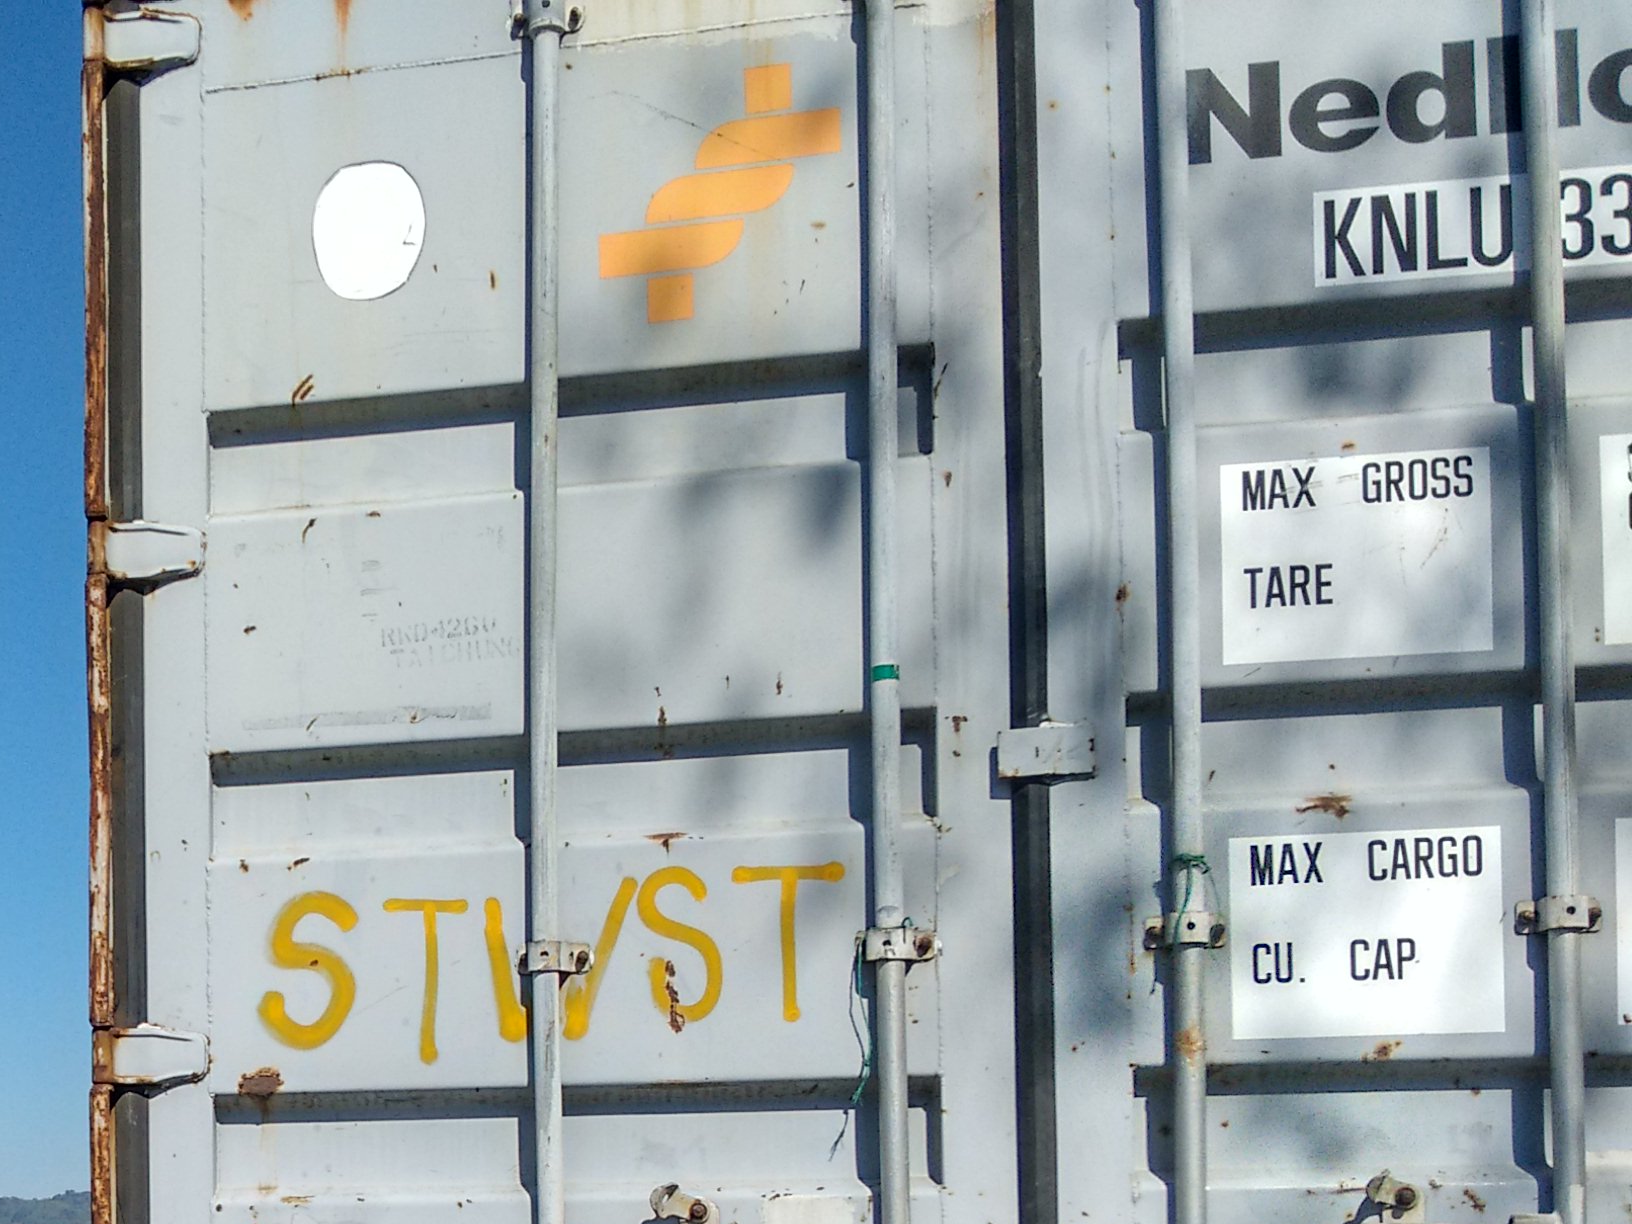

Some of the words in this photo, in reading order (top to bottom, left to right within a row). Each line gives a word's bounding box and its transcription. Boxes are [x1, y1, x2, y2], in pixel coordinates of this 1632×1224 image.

[1323, 184, 1514, 280] KNLU
[1242, 466, 1317, 511] MAX
[1363, 456, 1473, 504] GROSS
[1244, 564, 1334, 609] TARE
[1250, 841, 1324, 887] MAX
[1367, 835, 1483, 881] CARGO
[1252, 942, 1306, 985] CU.
[1349, 938, 1416, 981] CAP
